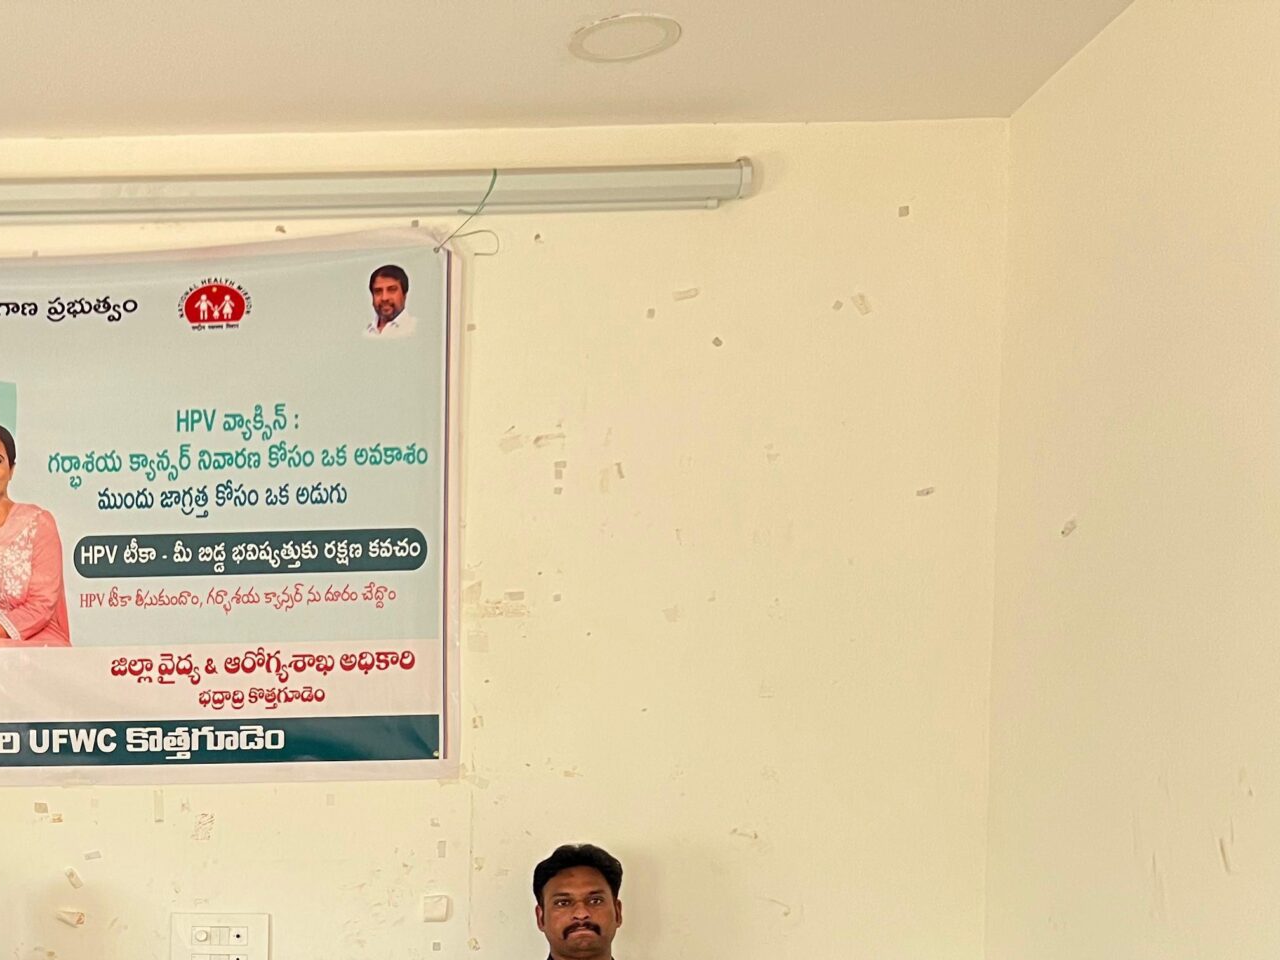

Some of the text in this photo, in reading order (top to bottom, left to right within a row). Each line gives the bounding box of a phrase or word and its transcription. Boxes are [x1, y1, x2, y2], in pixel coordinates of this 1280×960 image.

[46, 296, 138, 322] ప్రభుత్వం
[176, 408, 216, 432] HPV
[223, 403, 287, 441] వ్యాక్సిన్
[47, 440, 429, 489] గర్భాశయ క్యాన్సర్ నివారణ కోసం ఒక అవకాశం
[97, 479, 348, 518] ముందు జాగ్రత్త కోసం ఒక అడుగు
[80, 544, 118, 565] HPV
[123, 537, 156, 564] టీకా
[172, 539, 192, 562] మీ
[197, 541, 227, 573] బిడ్డ
[231, 540, 318, 569] భవిష్యత్తుకు
[324, 538, 363, 566] రక్షణ
[368, 537, 421, 558] కవచం
[79, 592, 106, 608] HPV
[108, 586, 132, 608] టీకా
[134, 587, 203, 611] తీసుకుందాం,
[264, 582, 305, 612] క్యాన్సర్
[306, 587, 321, 606] ను
[324, 584, 358, 603] దూరం
[361, 582, 397, 609] చేద్దాం
[110, 647, 416, 685] జిల్లా వైద్య & ఆరోగ్యశాఖ అధికారి
[198, 685, 326, 710] భద్రాద్రి కొత్తగూడెం
[29, 728, 118, 754] UFWC
[125, 724, 285, 760] కొత్తగూడెం
